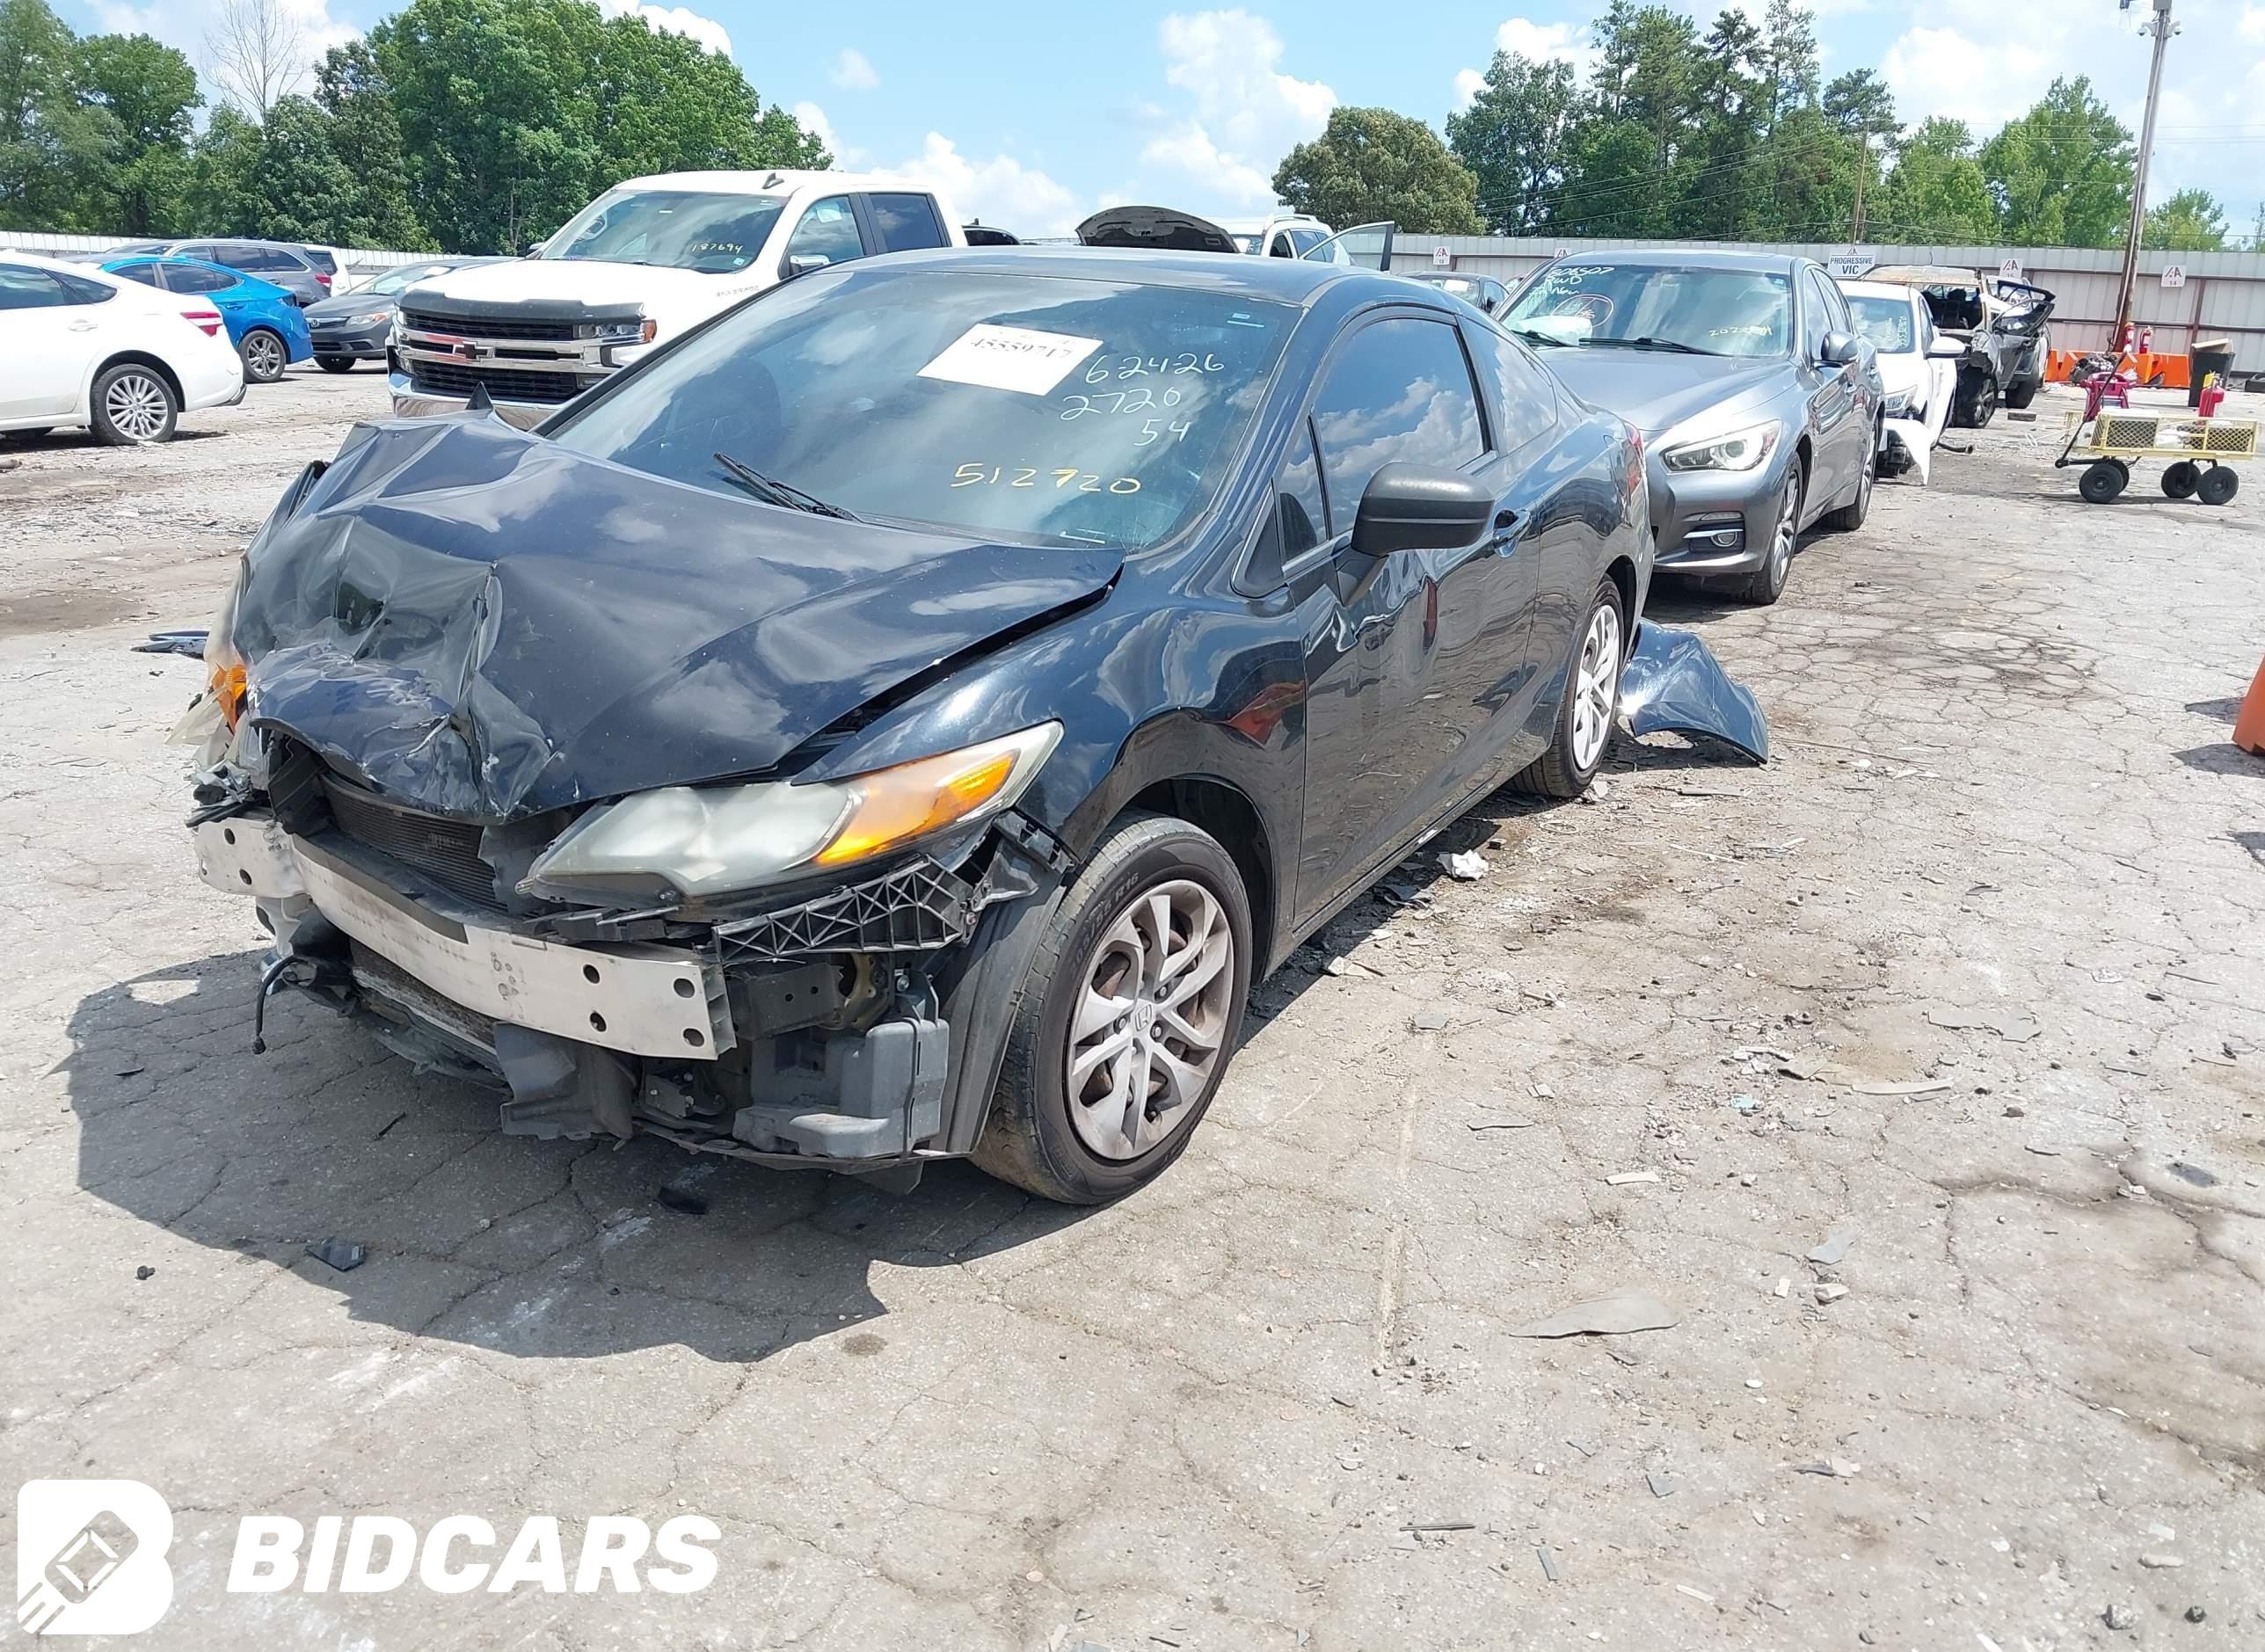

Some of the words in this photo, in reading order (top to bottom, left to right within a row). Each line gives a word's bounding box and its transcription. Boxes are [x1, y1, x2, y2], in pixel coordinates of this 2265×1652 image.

[691, 243, 744, 255] 187694
[1842, 265, 1860, 274] VIC
[1060, 387, 1181, 420] 2720
[1133, 418, 1193, 447] 54
[950, 462, 1141, 494] 512720
